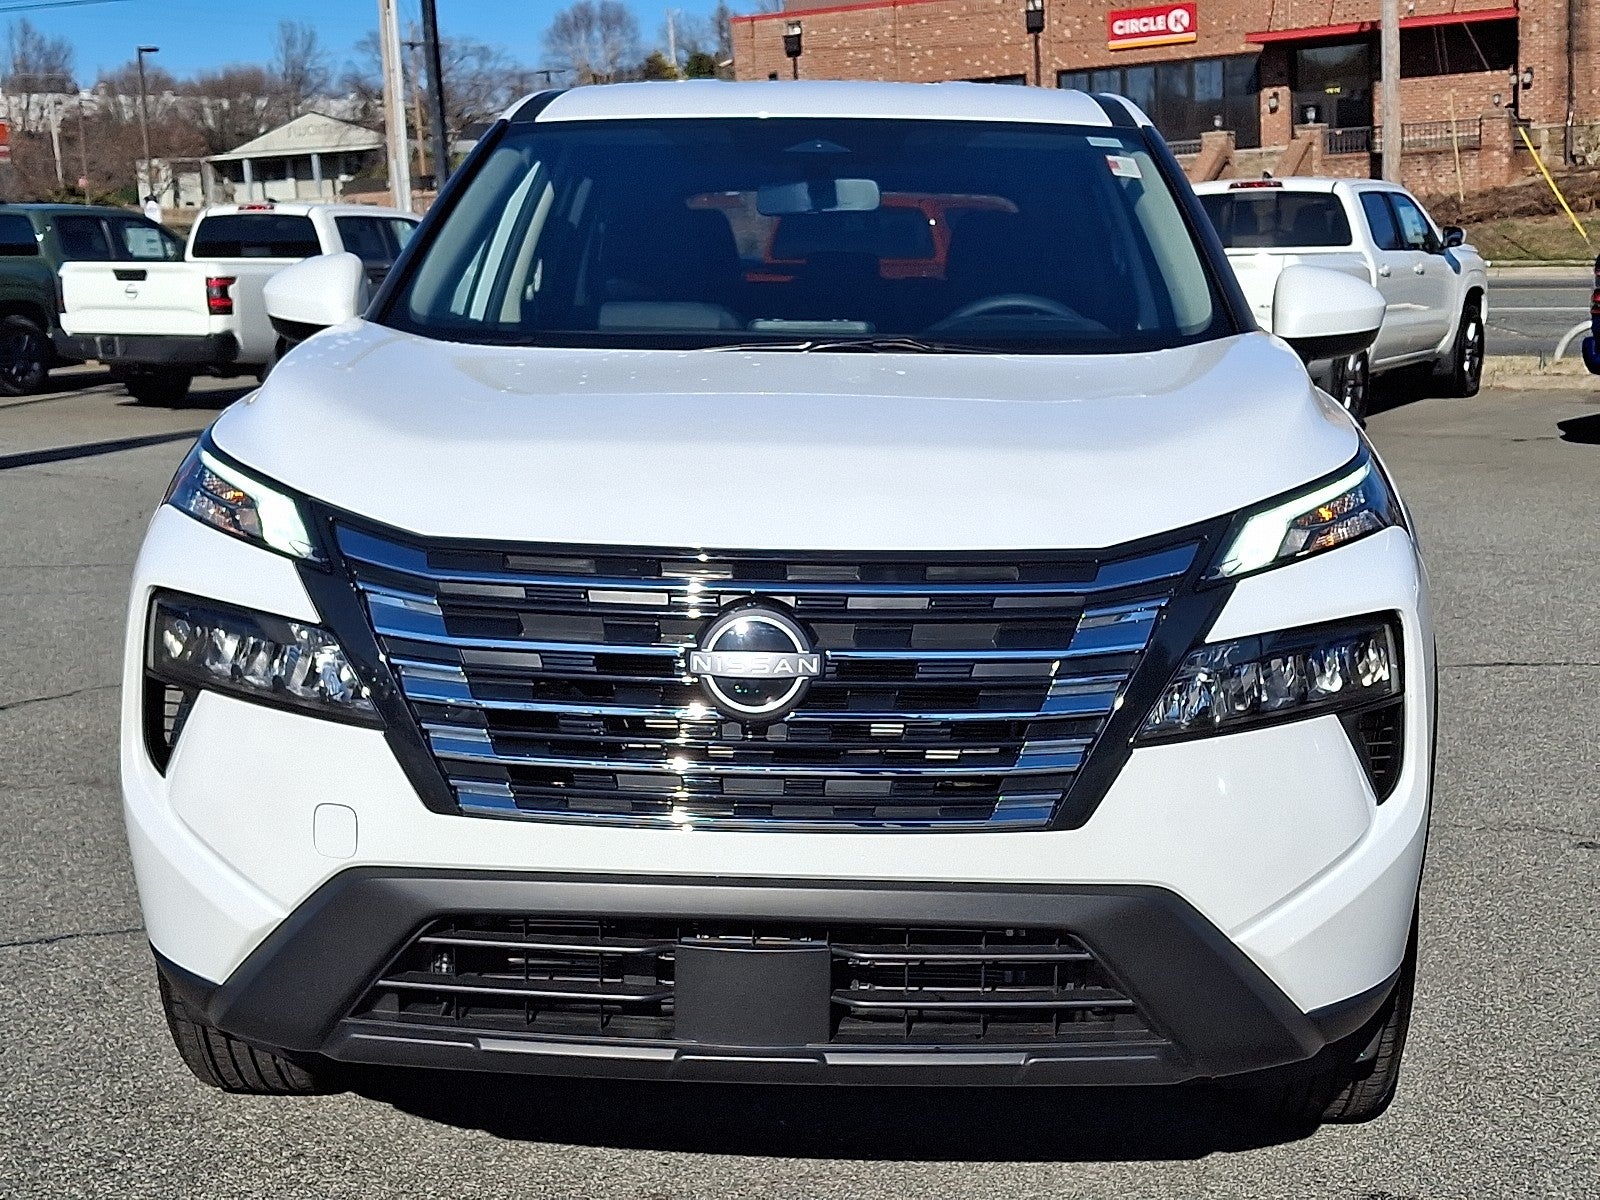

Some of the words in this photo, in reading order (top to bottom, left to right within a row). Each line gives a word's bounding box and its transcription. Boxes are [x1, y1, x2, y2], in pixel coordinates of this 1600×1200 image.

[1112, 14, 1167, 35] CIRCLE
[1168, 9, 1190, 32] K
[692, 655, 818, 674] NISSAN
